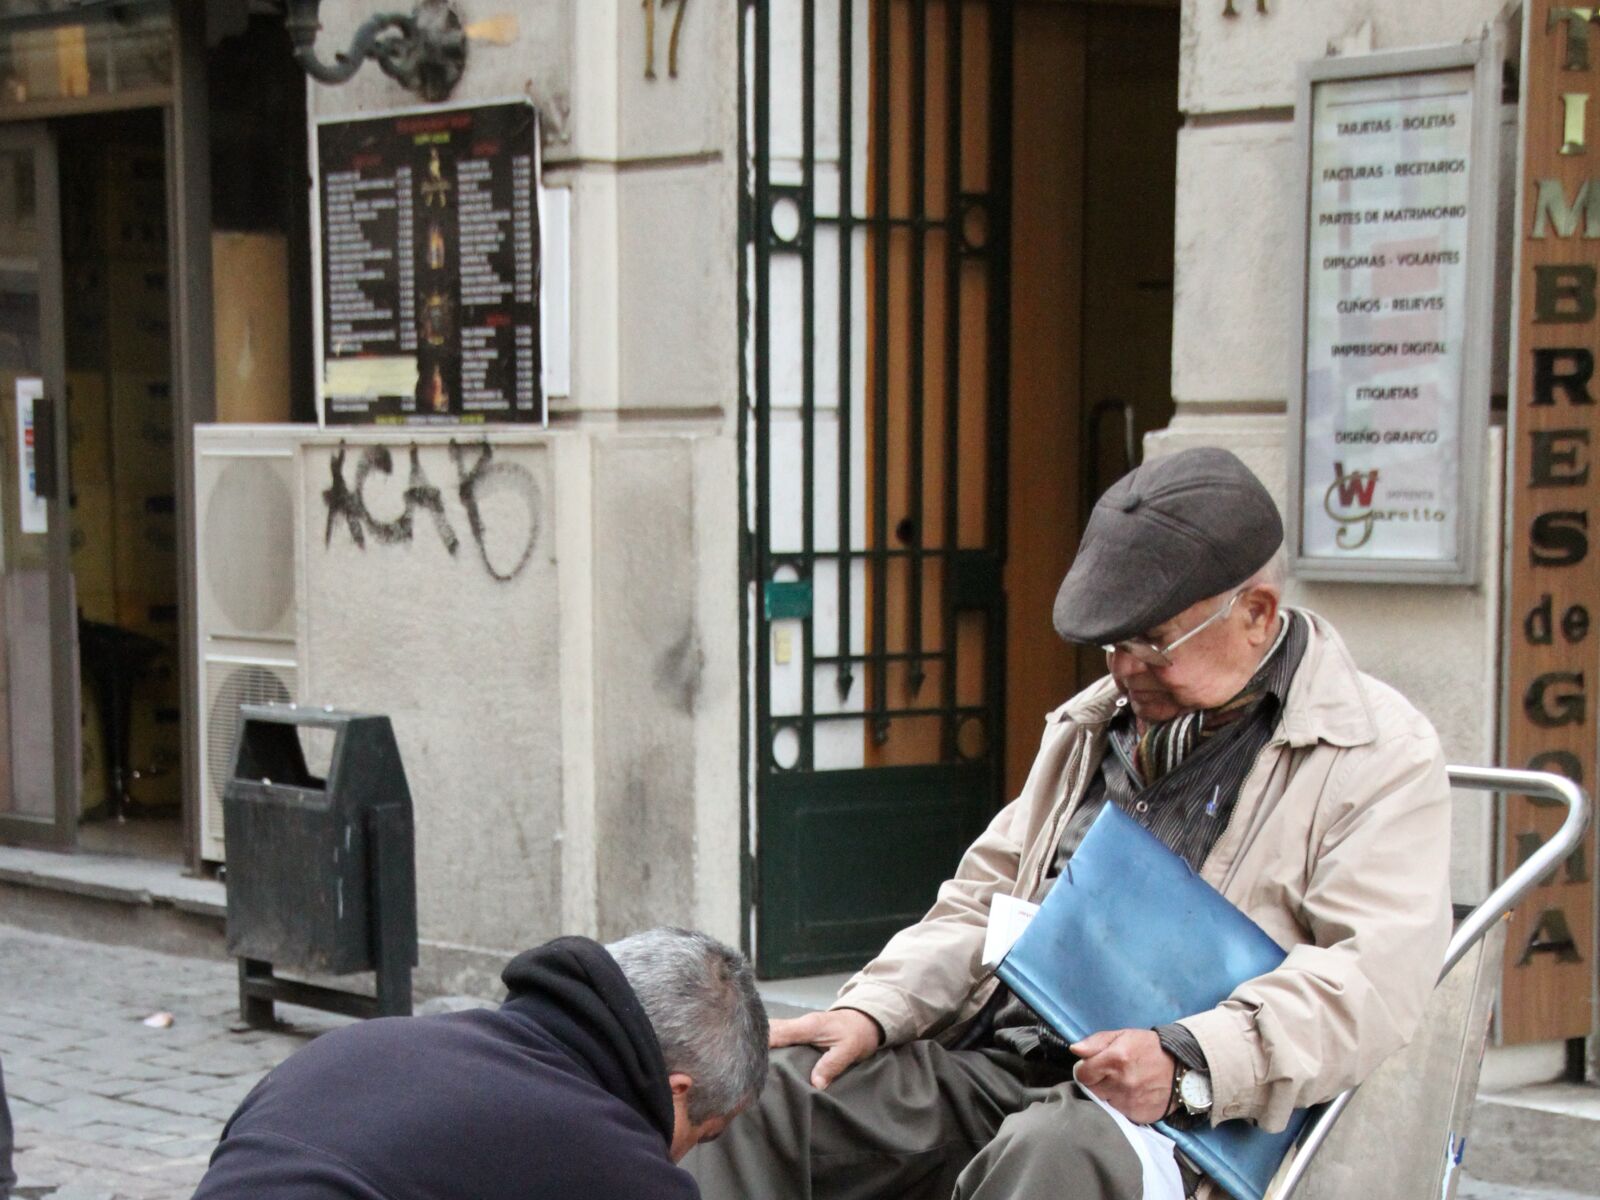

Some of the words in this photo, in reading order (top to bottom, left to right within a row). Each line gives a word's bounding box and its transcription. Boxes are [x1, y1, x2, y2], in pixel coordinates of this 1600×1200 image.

[1336, 119, 1391, 137] TARJETAS
[1403, 114, 1455, 131] BOLETAS
[1323, 165, 1384, 182] FACTURAS
[1394, 159, 1465, 177] RECETARIOS
[1319, 211, 1361, 227] PARTES
[1364, 209, 1379, 224] DE
[1382, 205, 1466, 223] MATRIMONIO
[1323, 255, 1386, 271] DIPLOMAS
[1397, 250, 1459, 267] VOLANTES
[1391, 296, 1444, 312] RELIEVES
[1401, 341, 1447, 356] DIGITAL
[1356, 386, 1419, 400] ETIQUETAS
[1524, 595, 1590, 645] de
